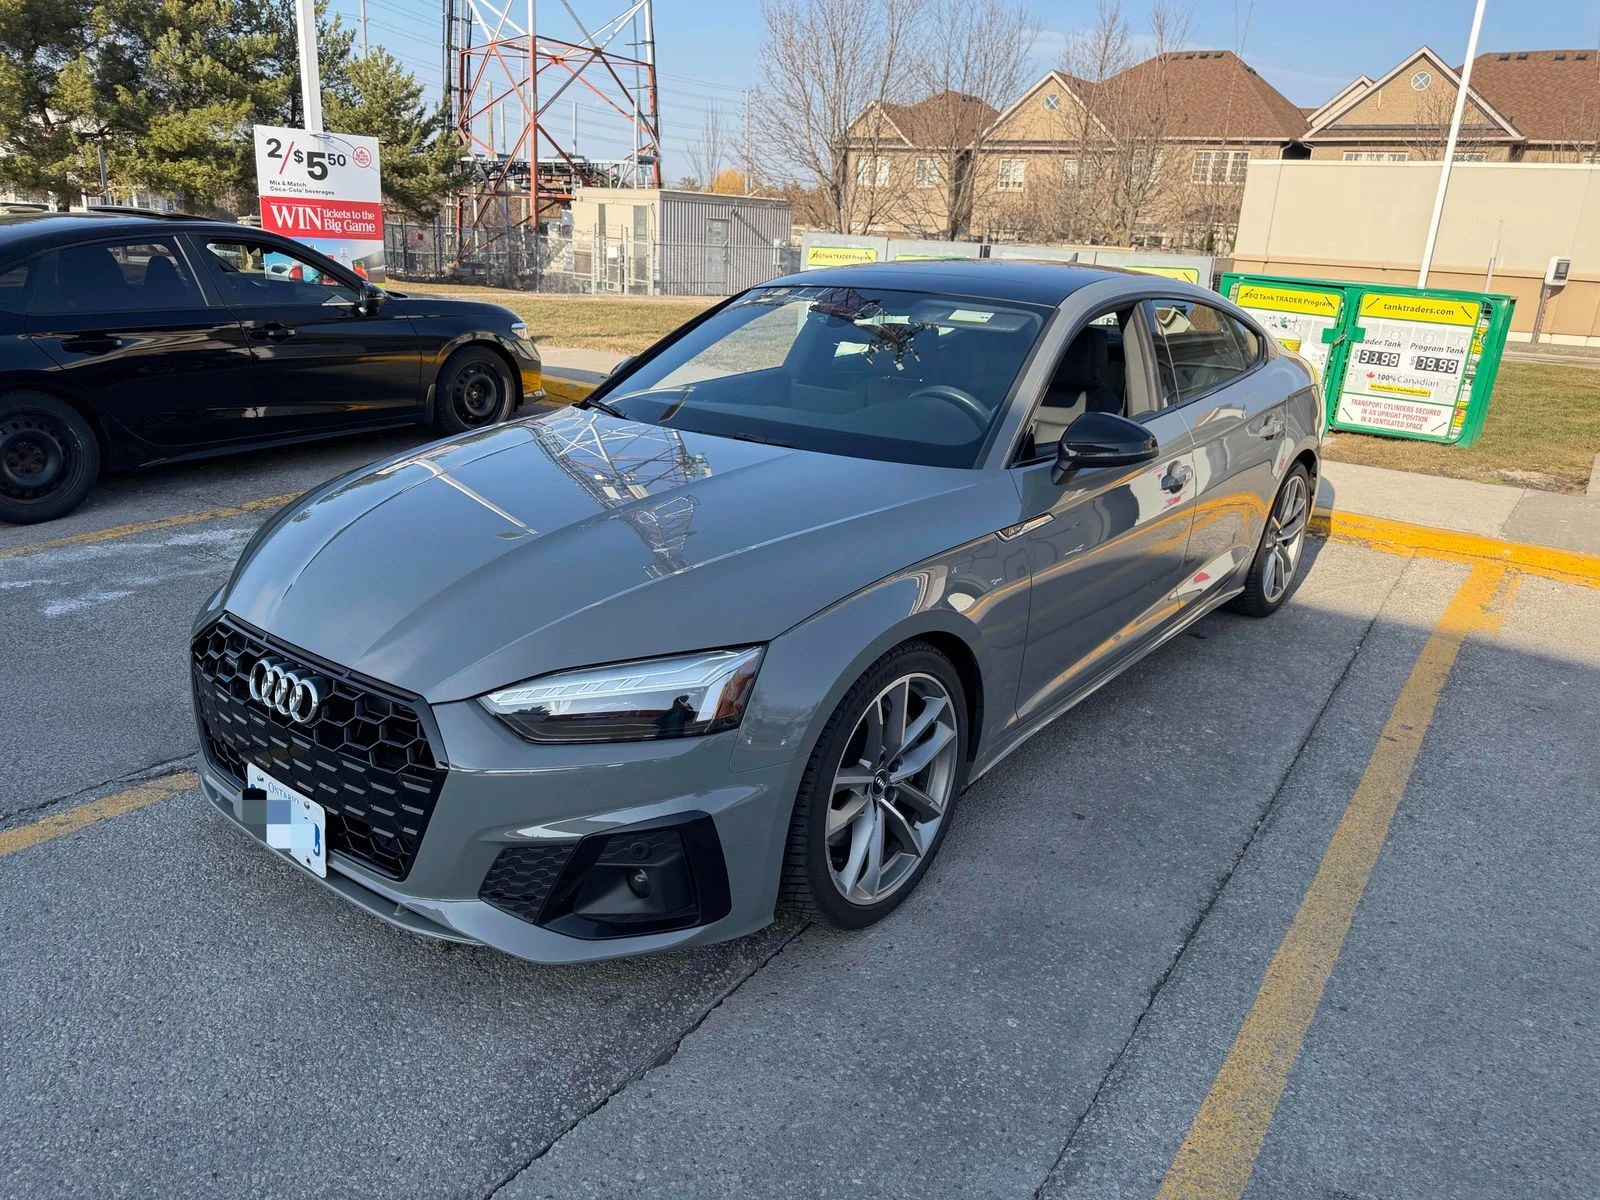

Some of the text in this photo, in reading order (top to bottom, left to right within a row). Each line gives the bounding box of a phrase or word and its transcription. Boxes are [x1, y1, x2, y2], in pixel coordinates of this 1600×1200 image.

[270, 205, 322, 230] WIN
[323, 208, 375, 220] tickets to the
[324, 218, 376, 233] Big Game
[1276, 296, 1302, 304] TRADER
[1384, 303, 1454, 316] tanktraders.com
[1410, 343, 1465, 354] Program Tank
[1377, 373, 1439, 387] 100% Canadian
[1351, 399, 1441, 416] TRANSPORT CYLINDERS SECURED
[1378, 410, 1402, 419] UPRIGHT
[1403, 413, 1428, 423] POSITION
[1372, 418, 1404, 428] VENTILATED
[1405, 422, 1423, 430] SPACE
